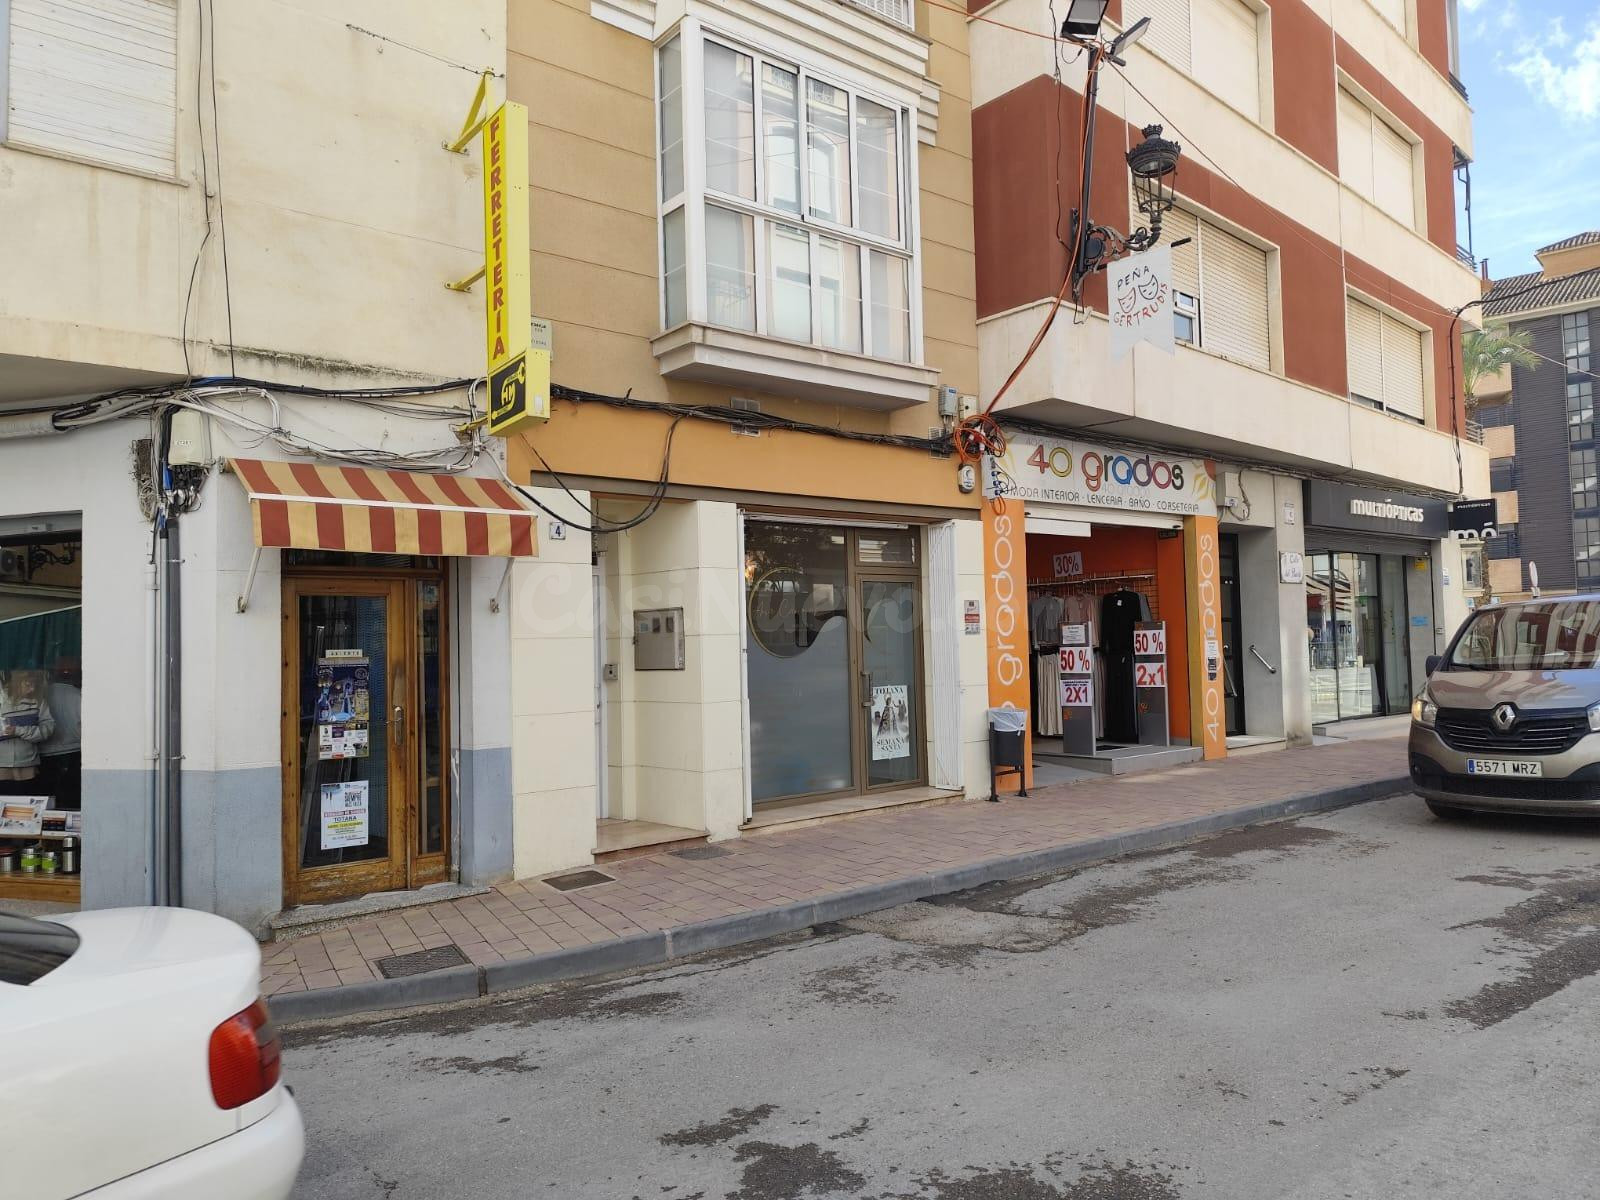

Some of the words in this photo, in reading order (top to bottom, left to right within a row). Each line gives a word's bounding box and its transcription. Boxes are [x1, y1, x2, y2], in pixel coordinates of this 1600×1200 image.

[489, 114, 506, 361] FERRETERIA
[1117, 265, 1150, 291] PEÑA
[1113, 282, 1168, 328] GERTRUDIS
[1026, 444, 1073, 478] 40
[1081, 454, 1185, 492] grados
[1010, 485, 1039, 498] MODA
[1041, 488, 1080, 502] INTERIOR
[1129, 496, 1151, 509] BAÑO
[1156, 500, 1200, 513] CORSETERIA
[555, 525, 562, 538] 4
[1055, 554, 1080, 575] 30%
[991, 514, 1023, 687] grados
[1135, 633, 1149, 654] 50
[1152, 631, 1164, 653] %
[1060, 649, 1075, 671] 50
[1078, 649, 1090, 672] %
[1136, 664, 1166, 686] 2x1
[1065, 686, 1088, 703] 2X1
[1476, 761, 1507, 774] 5571
[1512, 762, 1537, 775] MRZ
